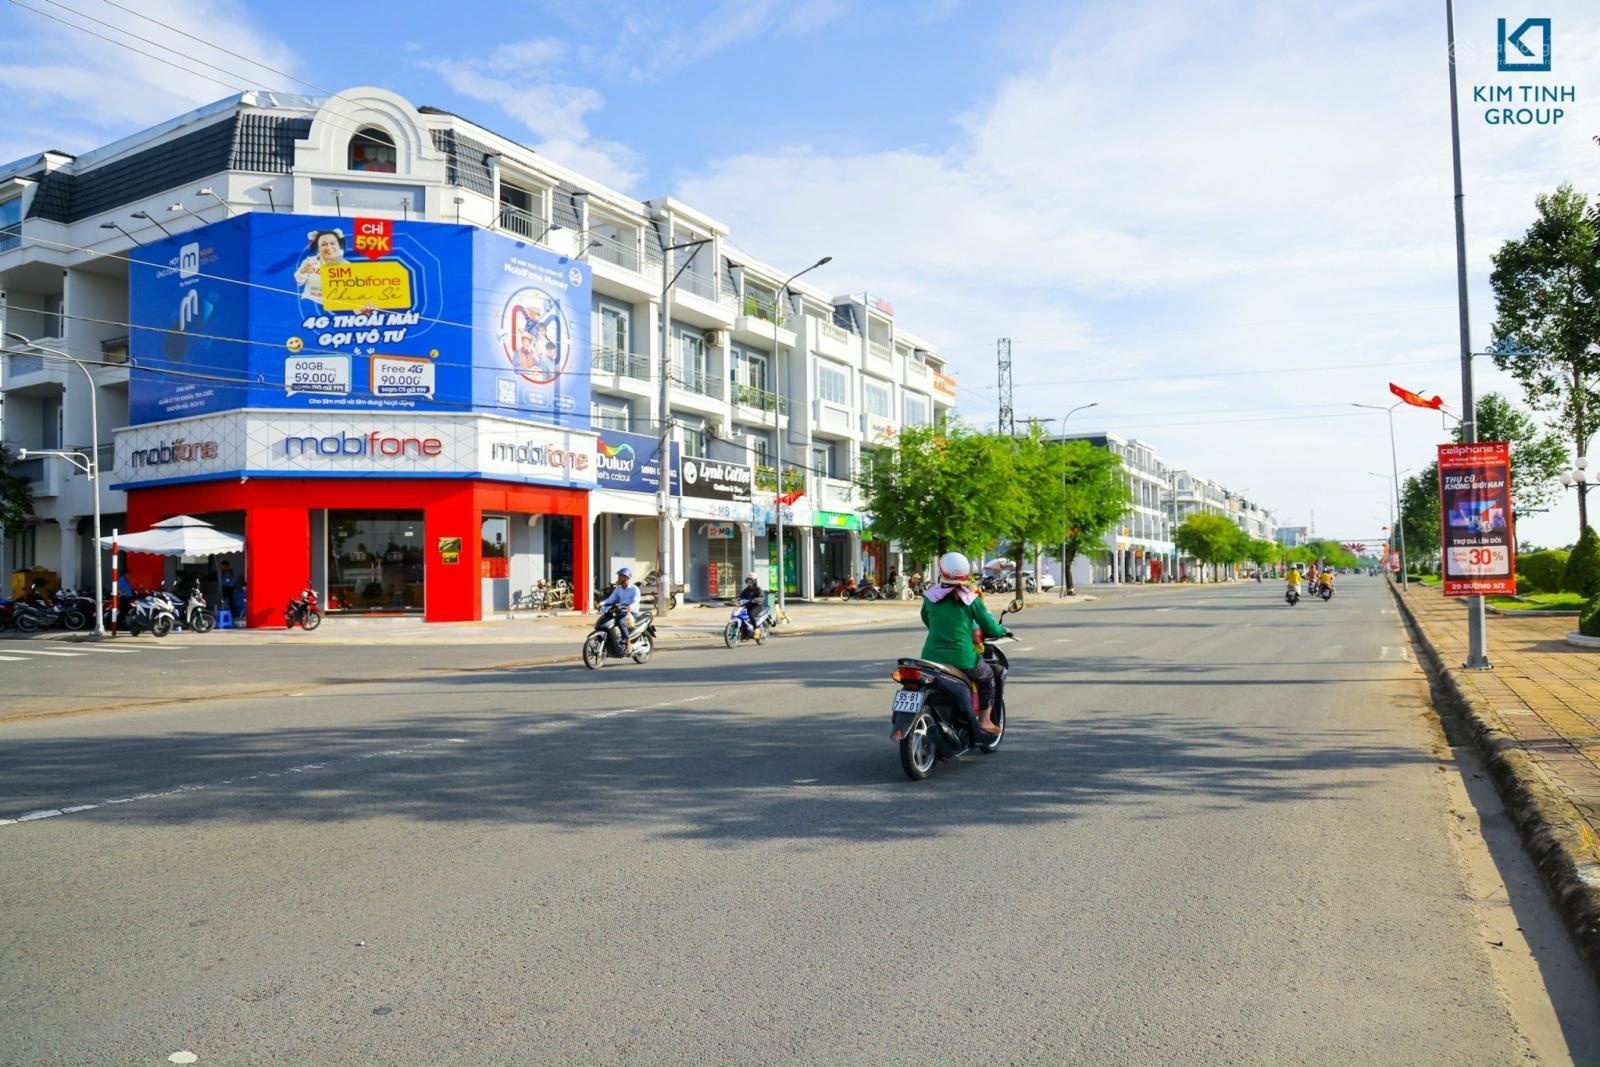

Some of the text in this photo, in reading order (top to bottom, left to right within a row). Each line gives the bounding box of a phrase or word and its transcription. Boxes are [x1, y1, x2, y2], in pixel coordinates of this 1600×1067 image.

[361, 221, 384, 235] CHỈ
[355, 235, 390, 251] 59K
[328, 267, 352, 279] SIM
[328, 276, 401, 288] mobifone
[303, 316, 330, 330] 4G
[318, 328, 407, 348] GỌI VÔ TƯ
[294, 361, 323, 371] 60GB
[381, 364, 424, 375] Free 4G
[284, 430, 443, 458] mobifone
[132, 437, 218, 469] mobifone
[491, 438, 588, 471] mobifone
[597, 453, 631, 472] Dulux
[724, 465, 751, 484] Coffee
[1444, 482, 1471, 490] KHÔNG
[718, 505, 730, 517] MB
